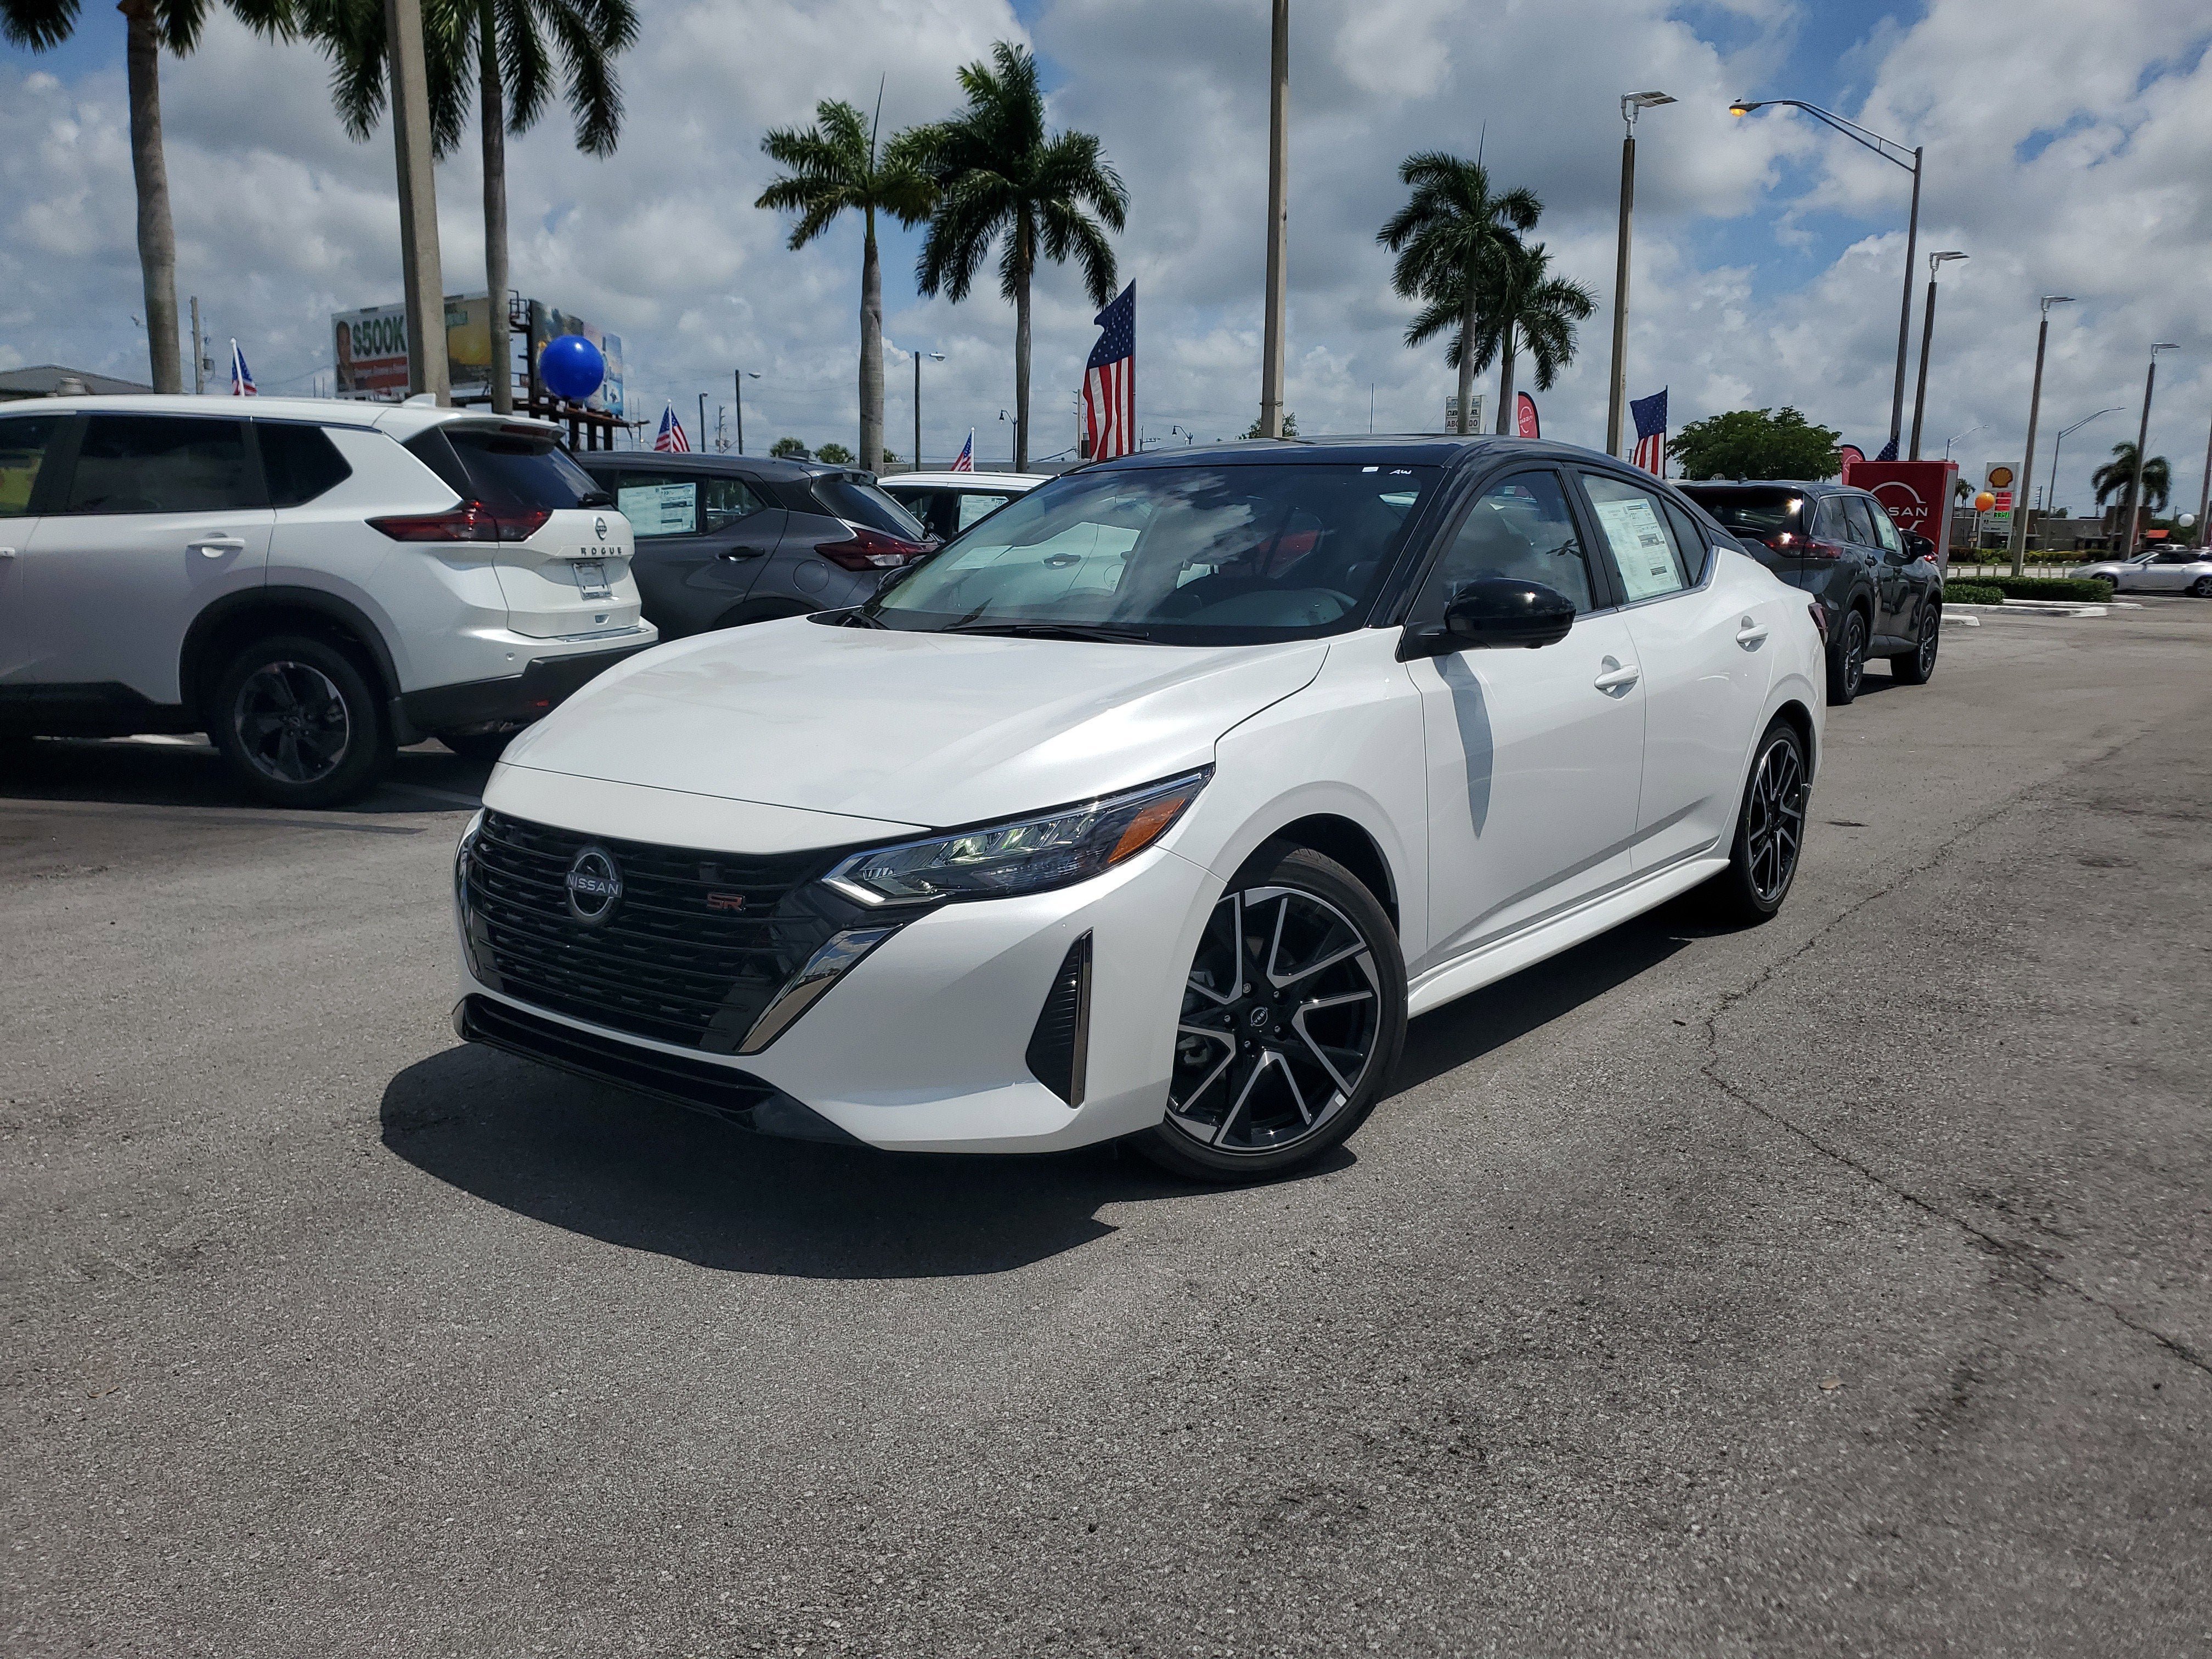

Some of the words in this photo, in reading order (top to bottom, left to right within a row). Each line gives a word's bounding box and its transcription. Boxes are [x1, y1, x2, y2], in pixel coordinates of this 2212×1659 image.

[353, 315, 407, 357] $500K
[1888, 507, 1928, 516] SAN
[580, 547, 622, 556] ROGUE
[567, 874, 618, 895] NISSAN
[707, 893, 746, 912] SR
